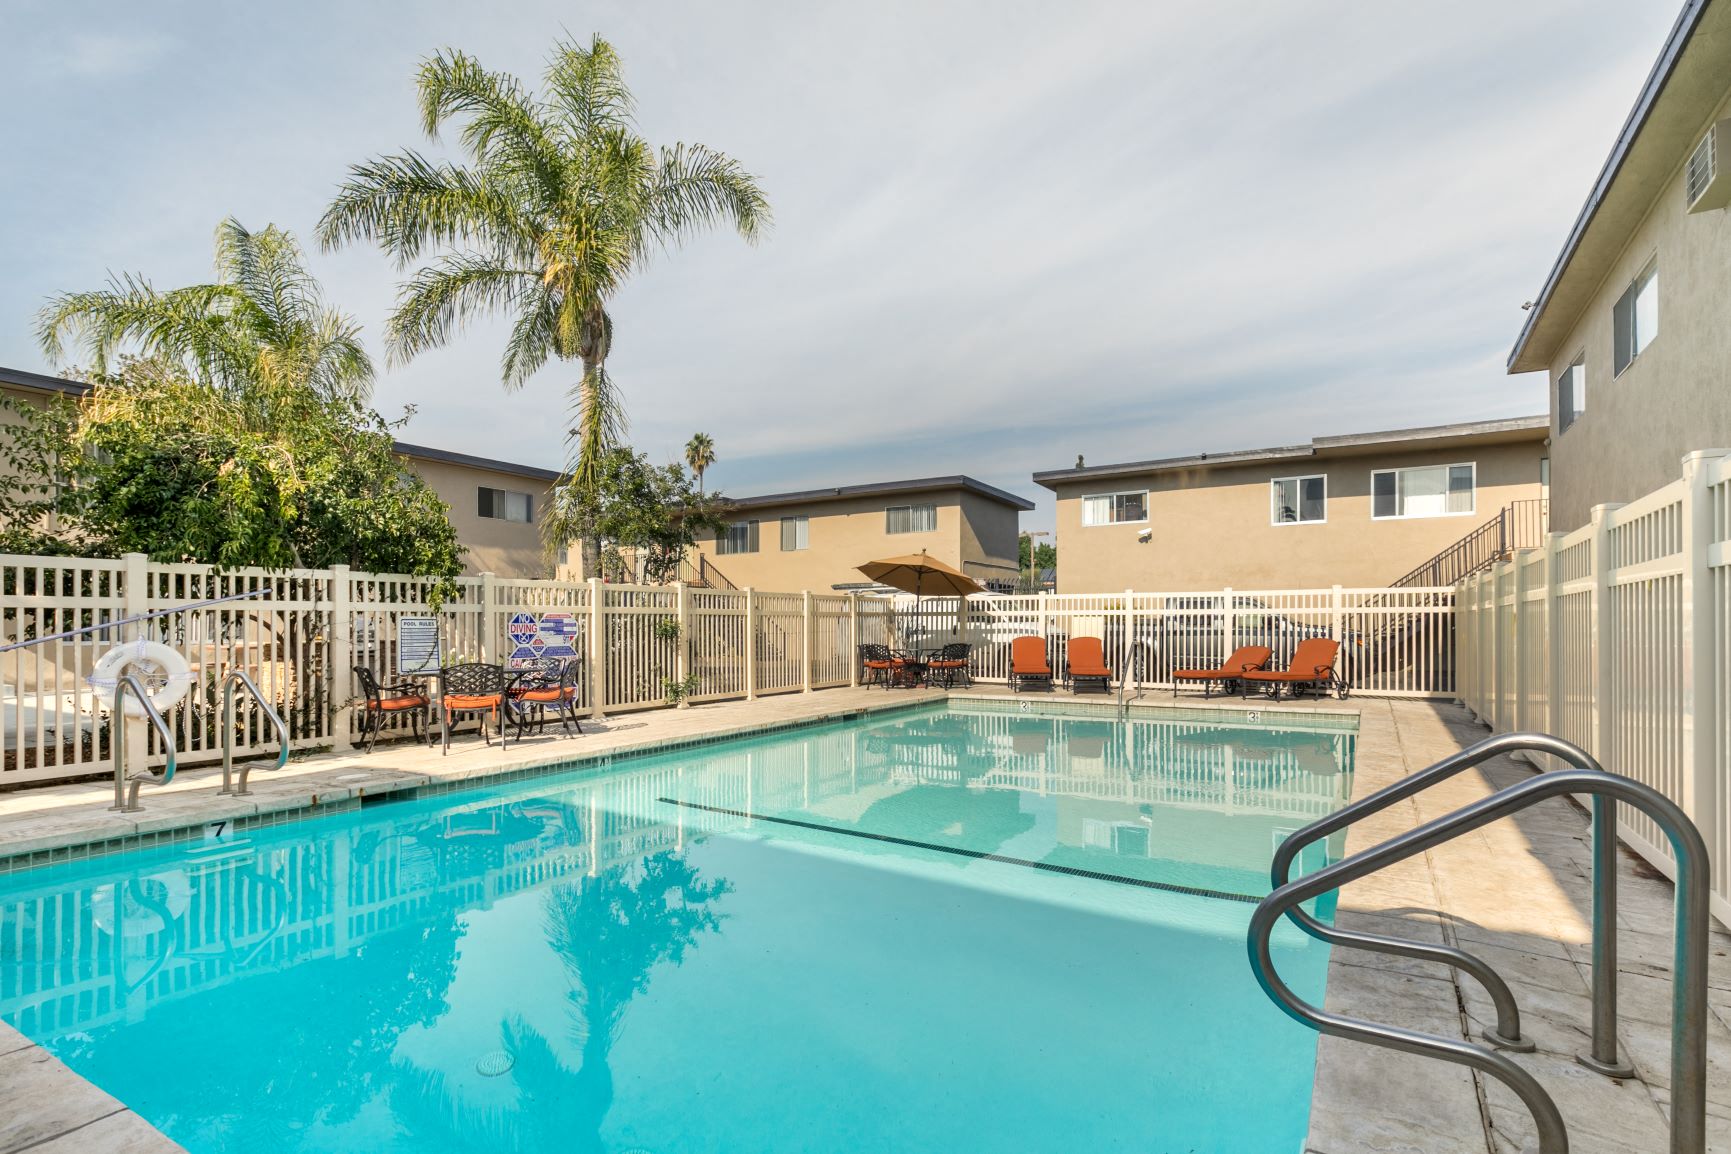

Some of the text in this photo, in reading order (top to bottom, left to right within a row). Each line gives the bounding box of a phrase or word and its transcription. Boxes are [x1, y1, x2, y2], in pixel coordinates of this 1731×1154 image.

[518, 614, 530, 623] NO
[510, 624, 537, 633] DIVING
[211, 821, 227, 837] 7
